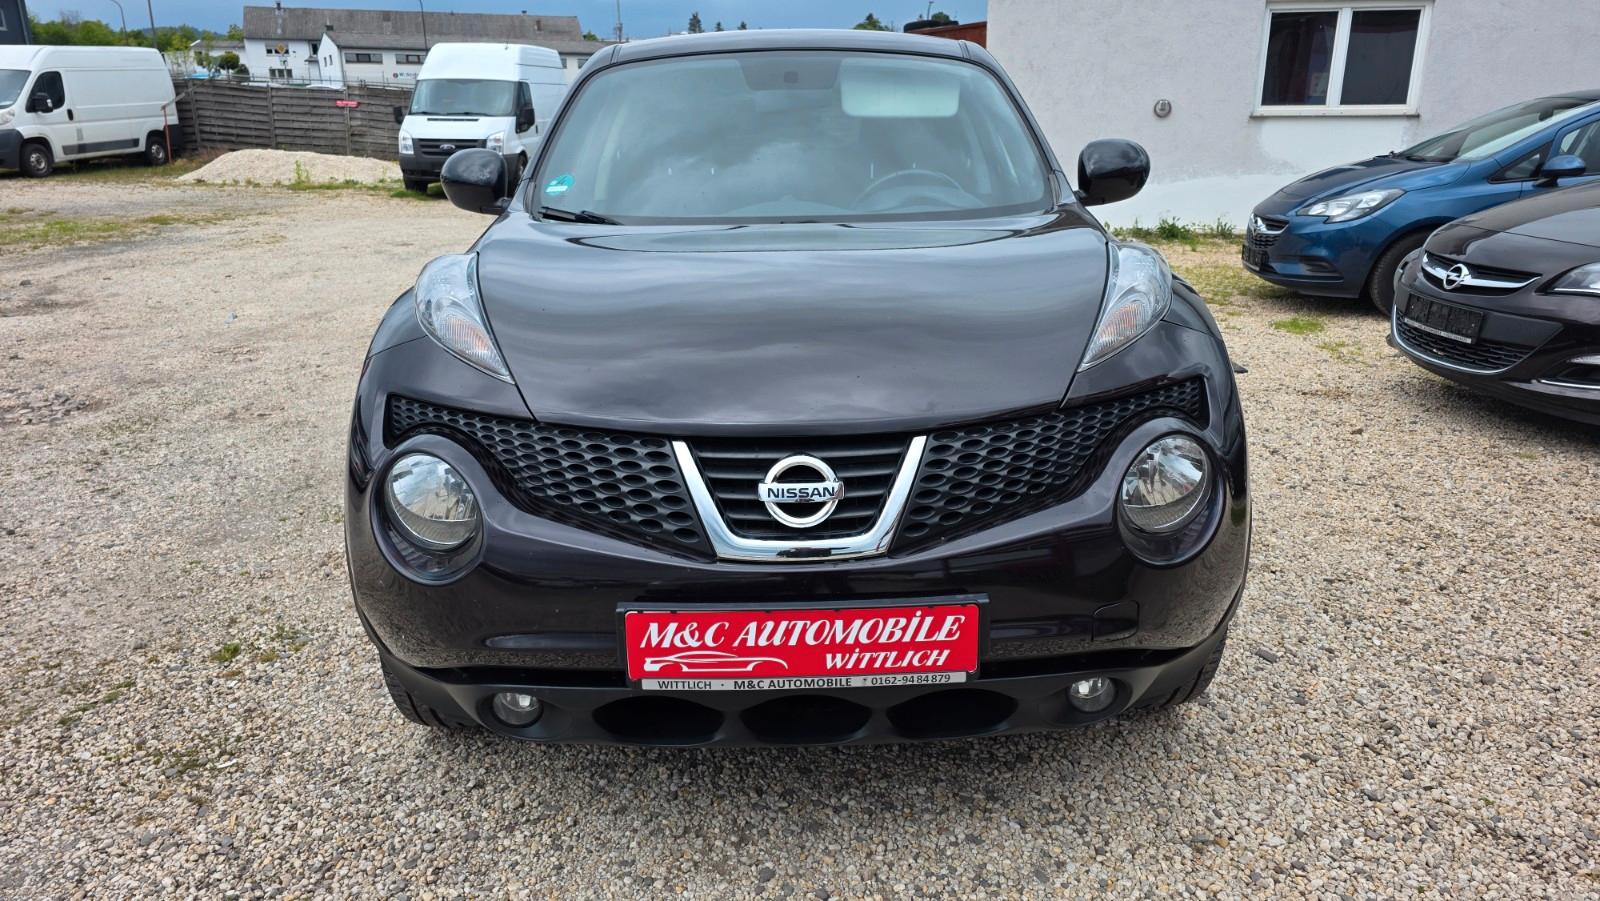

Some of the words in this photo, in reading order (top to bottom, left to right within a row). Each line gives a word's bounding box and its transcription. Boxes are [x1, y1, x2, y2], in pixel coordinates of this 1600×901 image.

[767, 486, 835, 499] NISSAN
[639, 621, 730, 648] M&C
[657, 680, 712, 690] WITTLICH
[734, 679, 765, 690] M&C
[768, 677, 851, 689] AUTOMOBILE
